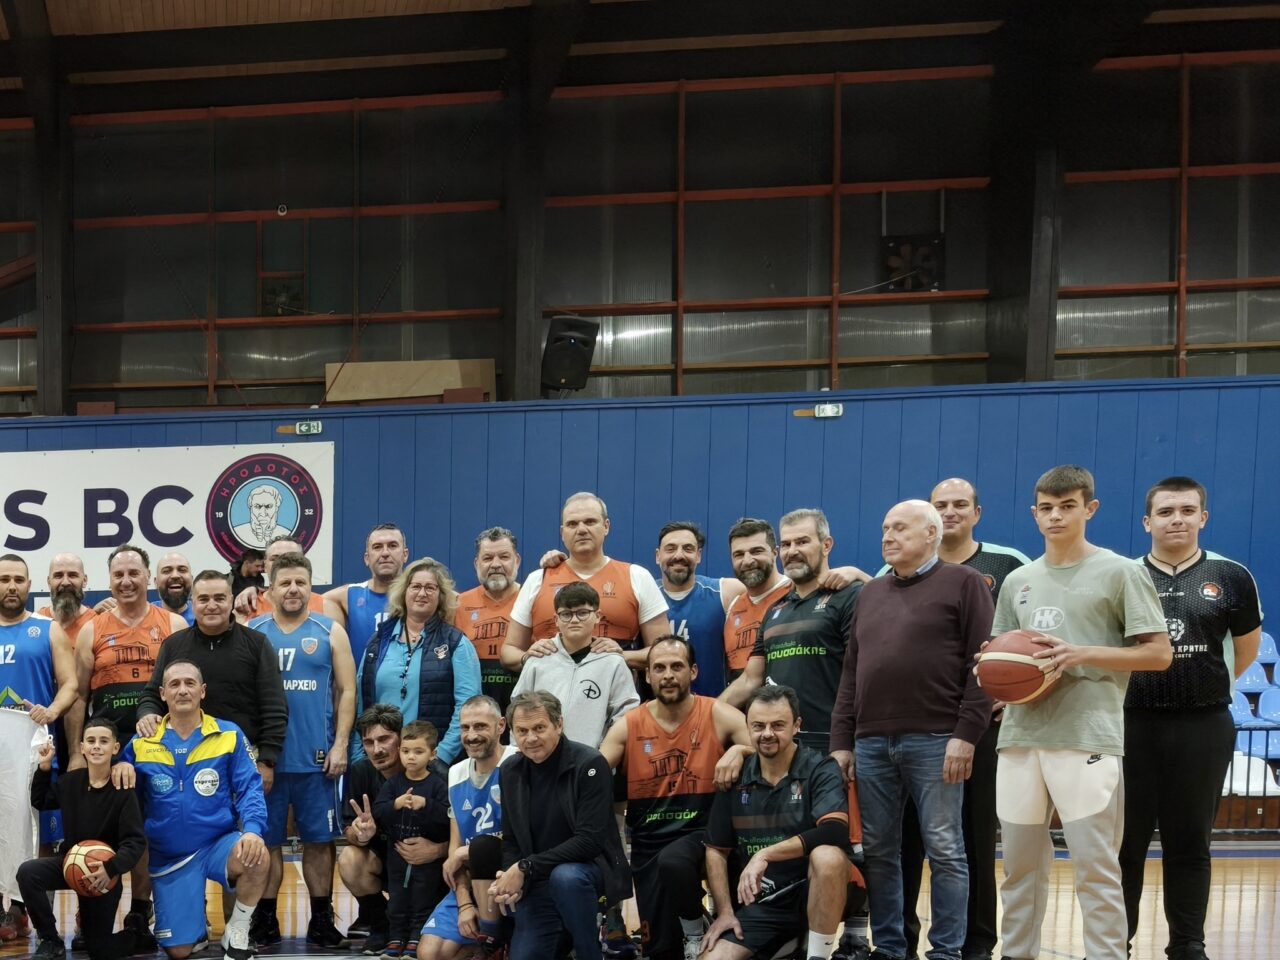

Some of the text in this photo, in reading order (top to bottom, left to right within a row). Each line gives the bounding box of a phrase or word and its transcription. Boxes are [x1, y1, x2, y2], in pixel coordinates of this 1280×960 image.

[220, 463, 309, 498] ΗΡΟΔΟΤΟΣ
[83, 484, 195, 550] BC
[304, 508, 314, 516] 32
[670, 619, 690, 641] 14
[278, 647, 296, 672] 17
[488, 644, 497, 655] 11
[132, 667, 140, 679] 6
[471, 802, 494, 833] 22
